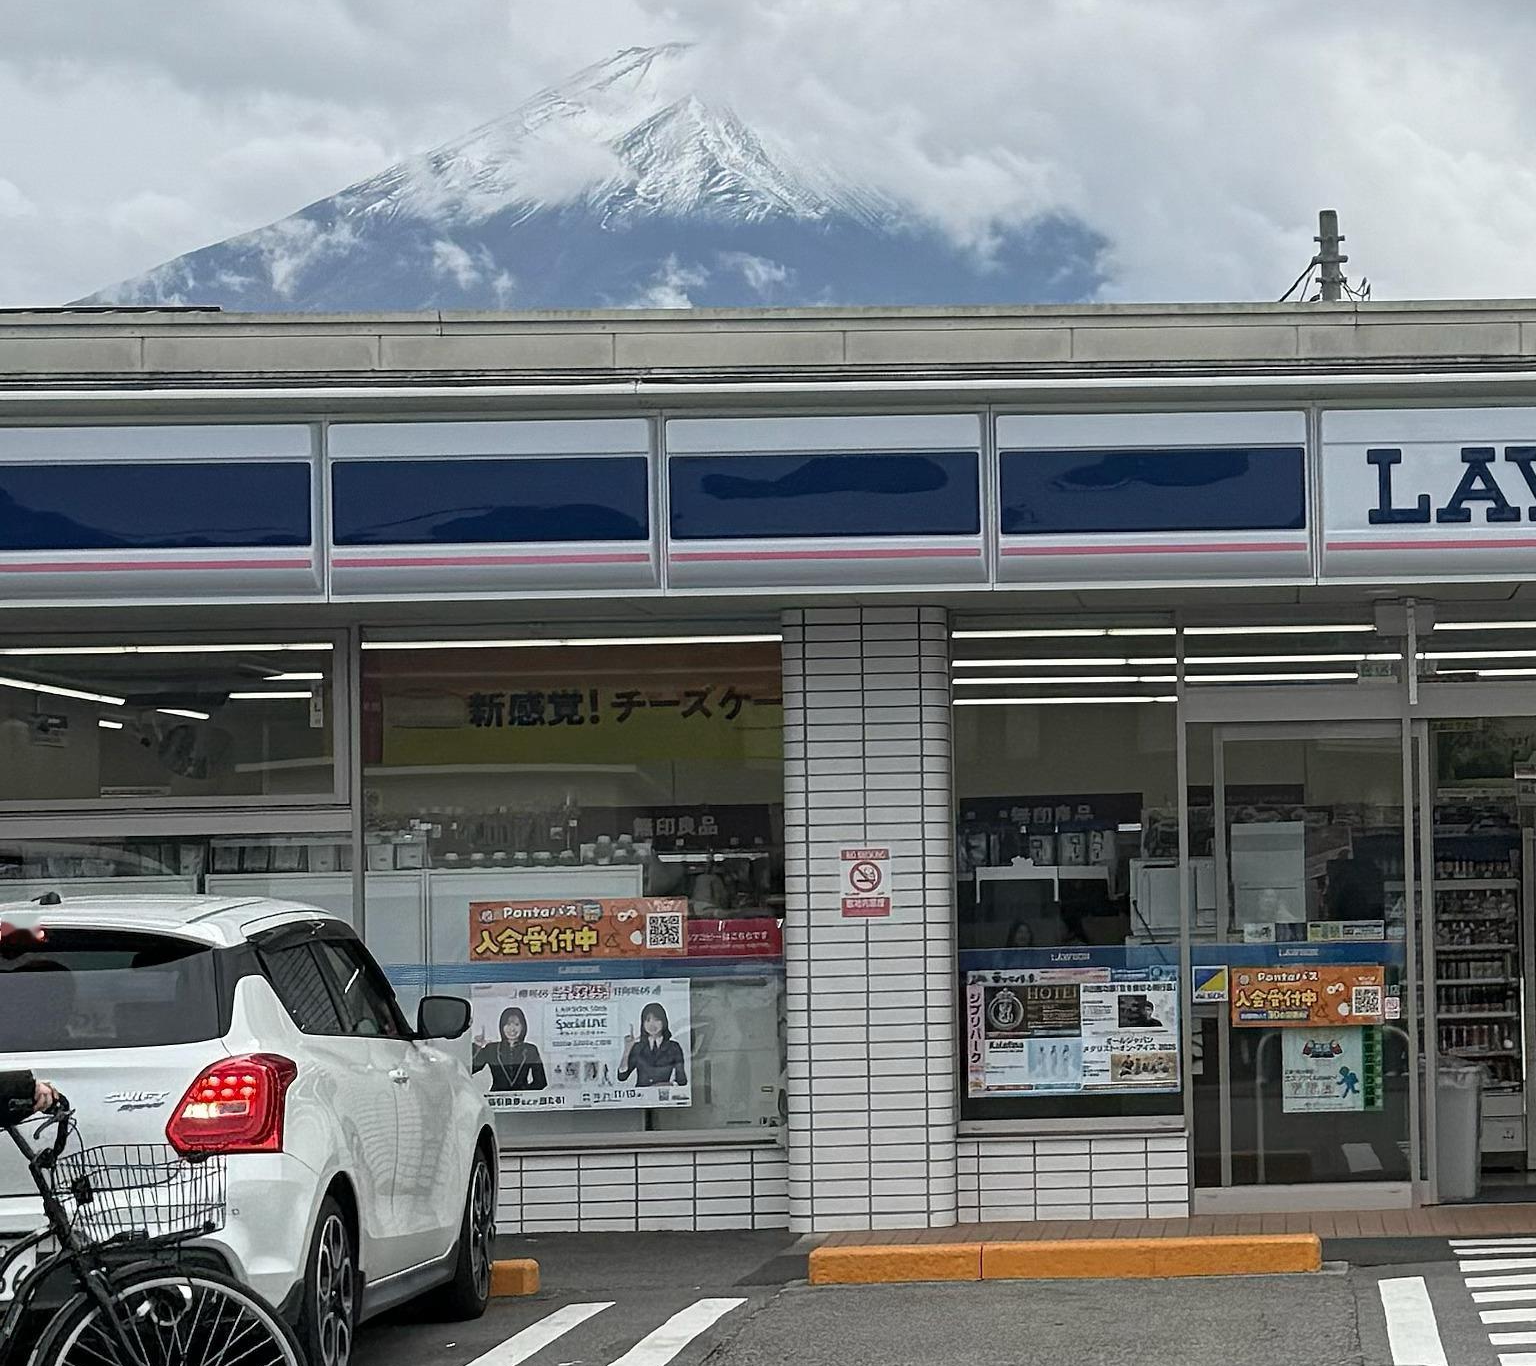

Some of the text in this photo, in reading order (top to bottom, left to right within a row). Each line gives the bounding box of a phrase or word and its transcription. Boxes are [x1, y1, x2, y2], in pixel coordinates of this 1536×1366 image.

[502, 904, 577, 920] Pontaパス
[474, 924, 598, 956] 入会受付中
[1257, 970, 1319, 982] Pontaパス
[1235, 988, 1318, 1008] 入会受付中
[104, 1091, 170, 1104] SWIFT
